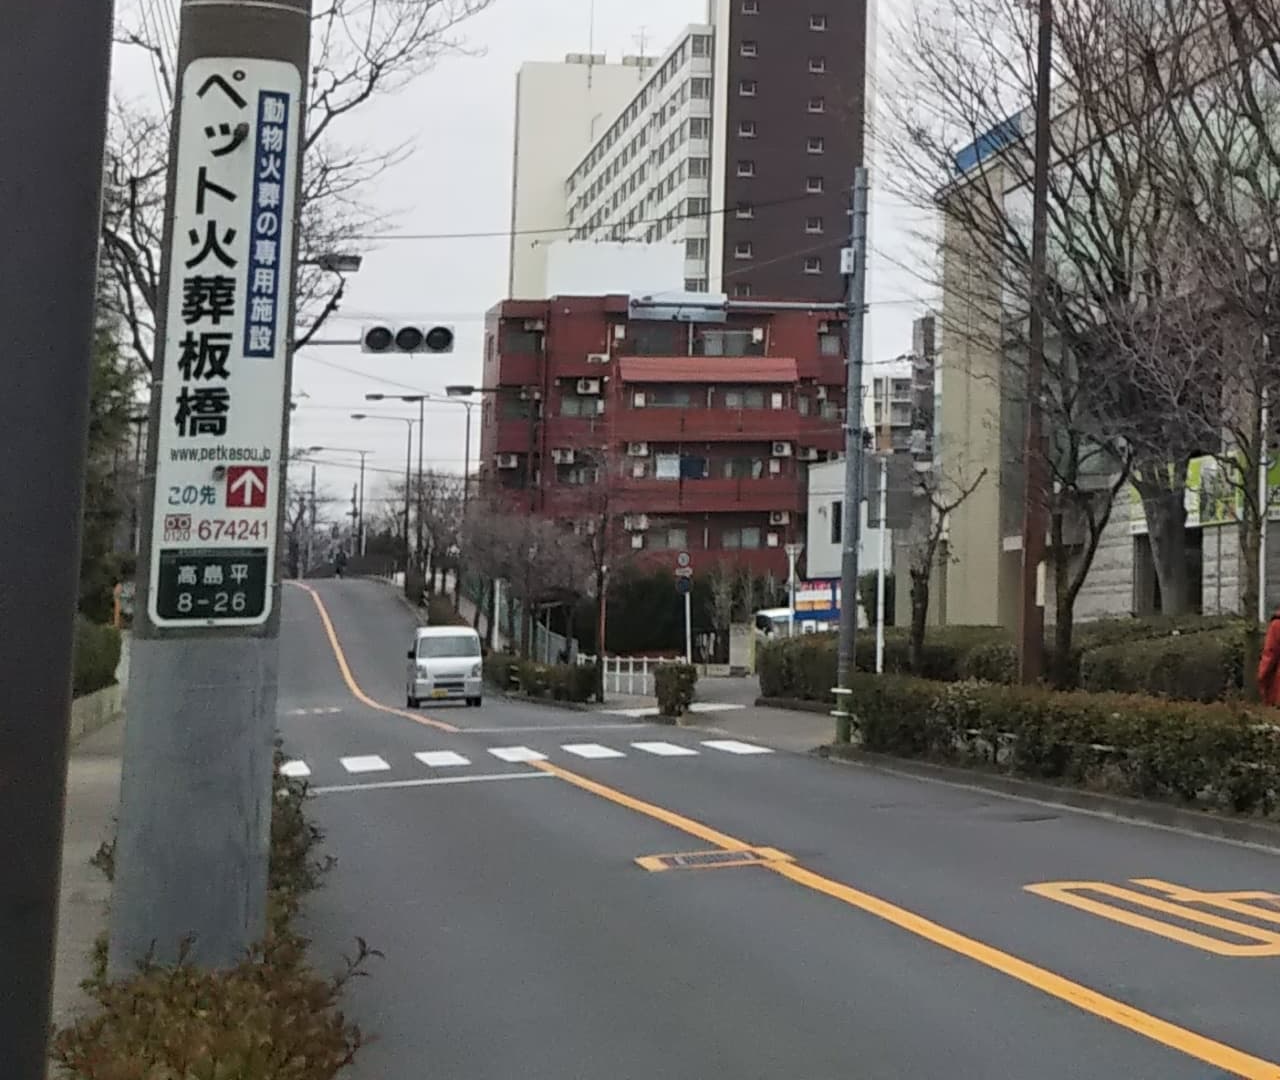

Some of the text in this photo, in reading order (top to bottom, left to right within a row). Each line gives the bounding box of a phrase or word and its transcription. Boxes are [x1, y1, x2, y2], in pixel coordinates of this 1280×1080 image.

[248, 97, 286, 352] 動物火葬の専用施設
[174, 70, 249, 438] ペット火葬板橋
[168, 485, 216, 506] この先
[198, 520, 268, 541] 674241
[178, 565, 249, 585] 高島平
[177, 593, 246, 613] 8-26
